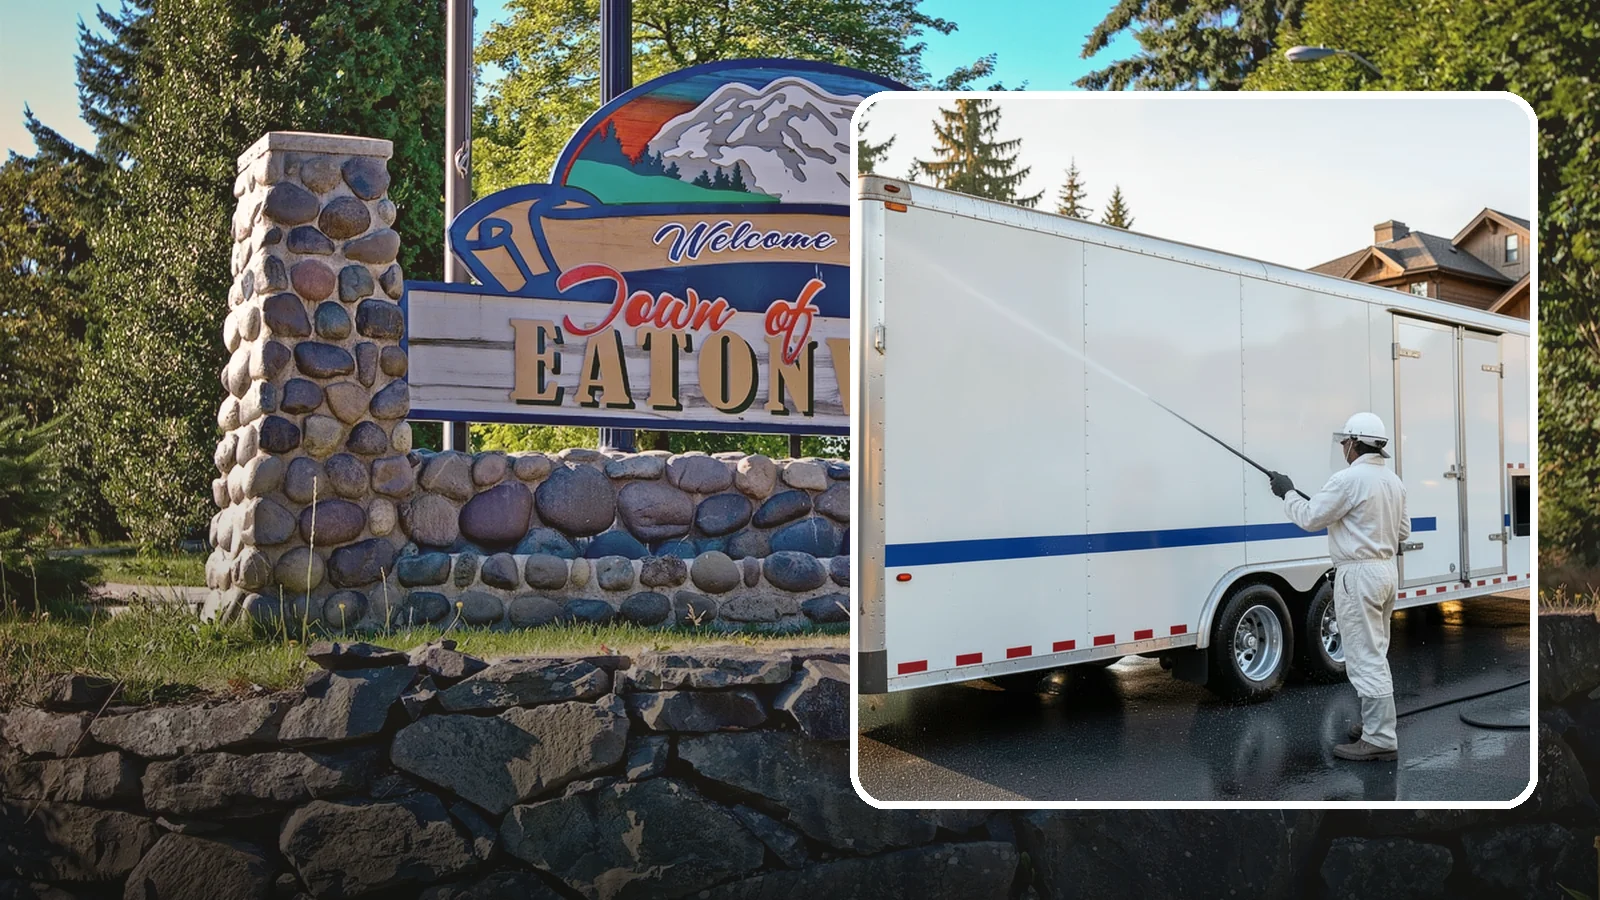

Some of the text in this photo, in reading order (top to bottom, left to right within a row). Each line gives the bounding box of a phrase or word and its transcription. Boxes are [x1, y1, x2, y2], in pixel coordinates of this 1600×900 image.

[654, 221, 837, 263] Welcome
[557, 263, 826, 365] Town of
